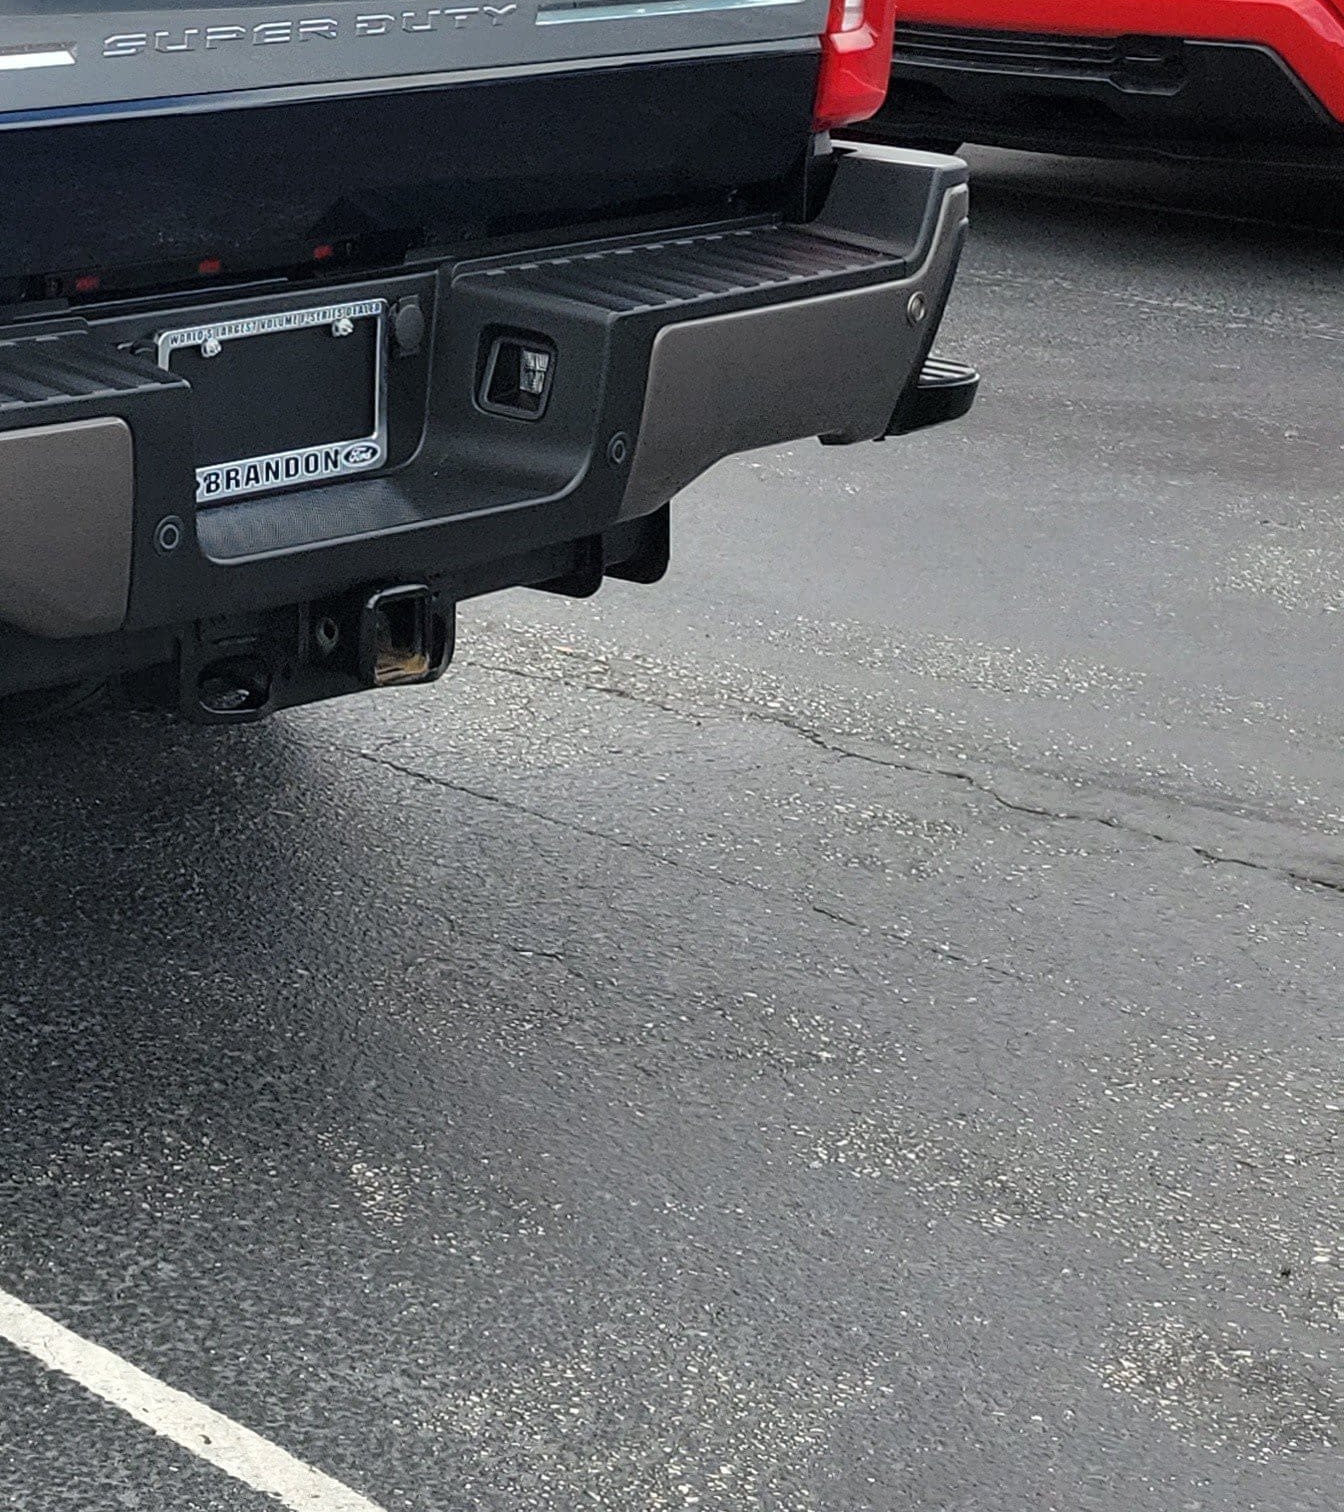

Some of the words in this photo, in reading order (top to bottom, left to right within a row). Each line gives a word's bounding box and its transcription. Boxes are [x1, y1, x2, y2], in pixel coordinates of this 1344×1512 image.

[103, 17, 338, 58] SUPER
[356, 3, 517, 37] DUTY
[203, 447, 340, 495] BRANDON
